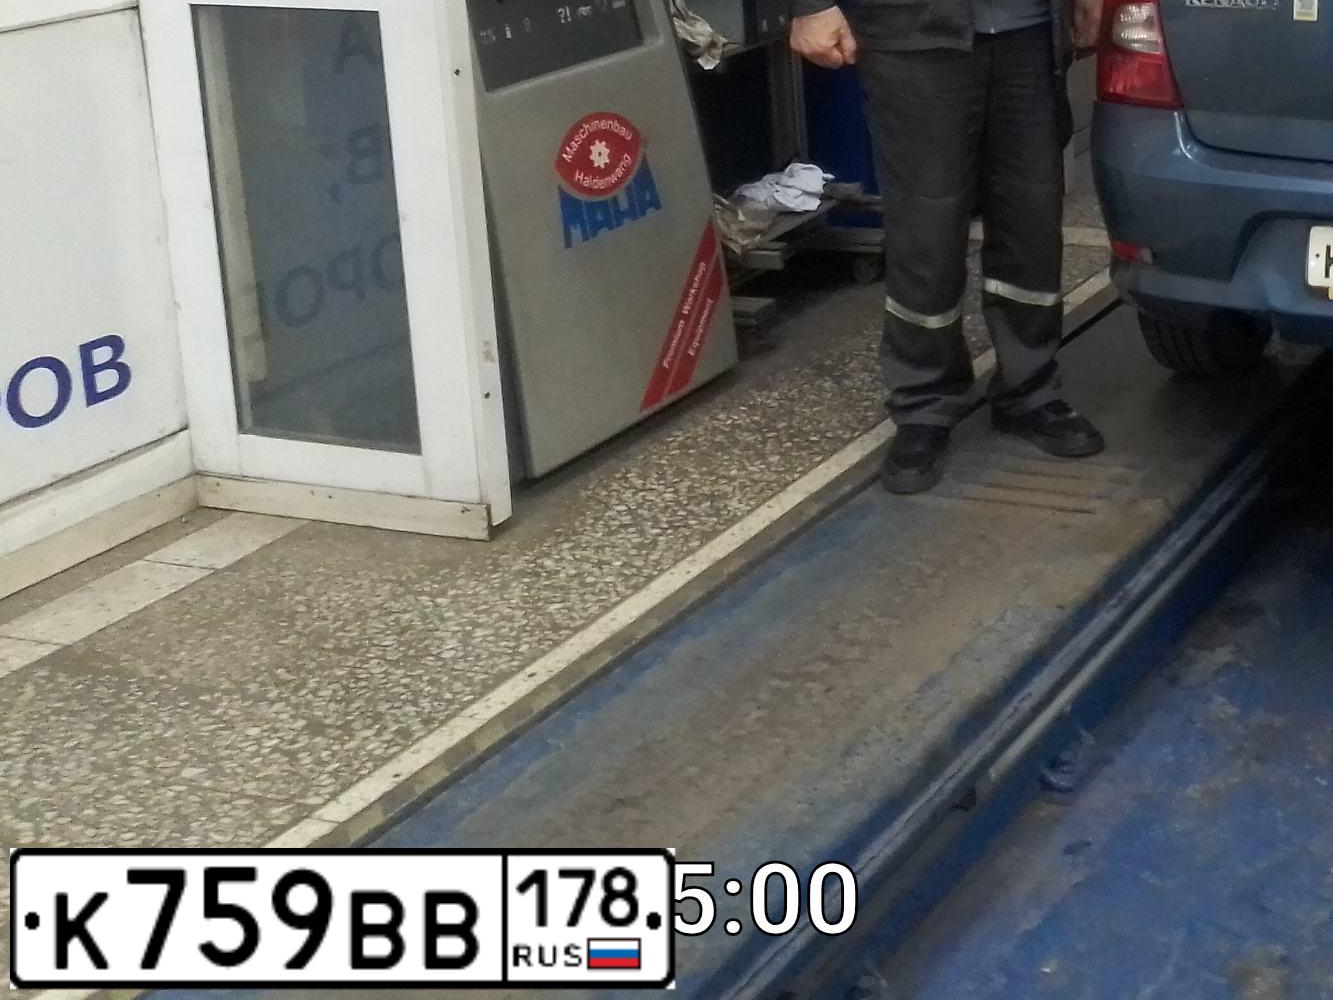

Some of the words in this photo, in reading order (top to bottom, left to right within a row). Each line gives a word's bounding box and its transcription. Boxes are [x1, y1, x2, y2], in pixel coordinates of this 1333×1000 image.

[561, 119, 633, 163] Maschinenbau
[574, 152, 633, 190] Haldenwang
[681, 261, 706, 315] Workshop
[6, 334, 132, 429] ОВ
